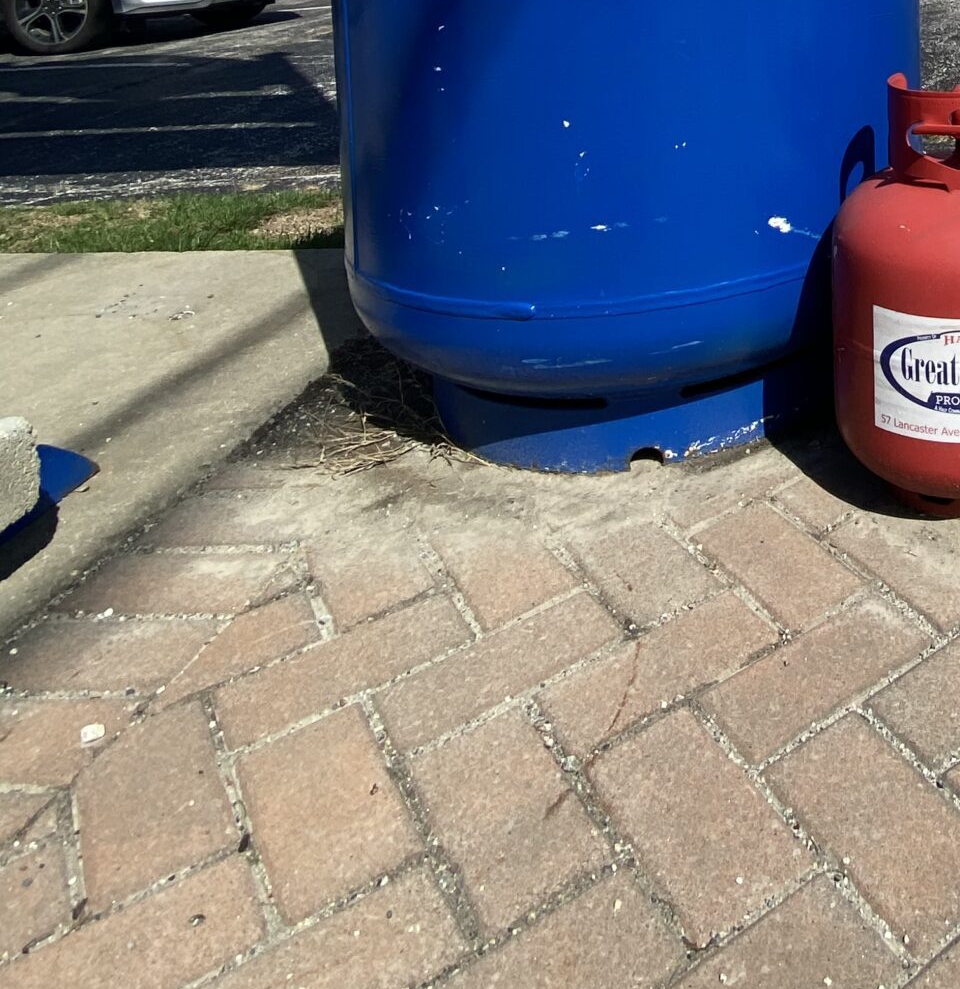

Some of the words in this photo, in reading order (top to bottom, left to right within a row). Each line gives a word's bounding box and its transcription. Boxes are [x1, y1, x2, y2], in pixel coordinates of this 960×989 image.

[901, 347, 959, 386] Great
[881, 413, 892, 424] 57
[894, 417, 938, 435] Lancaster
[941, 426, 960, 437] Ave
